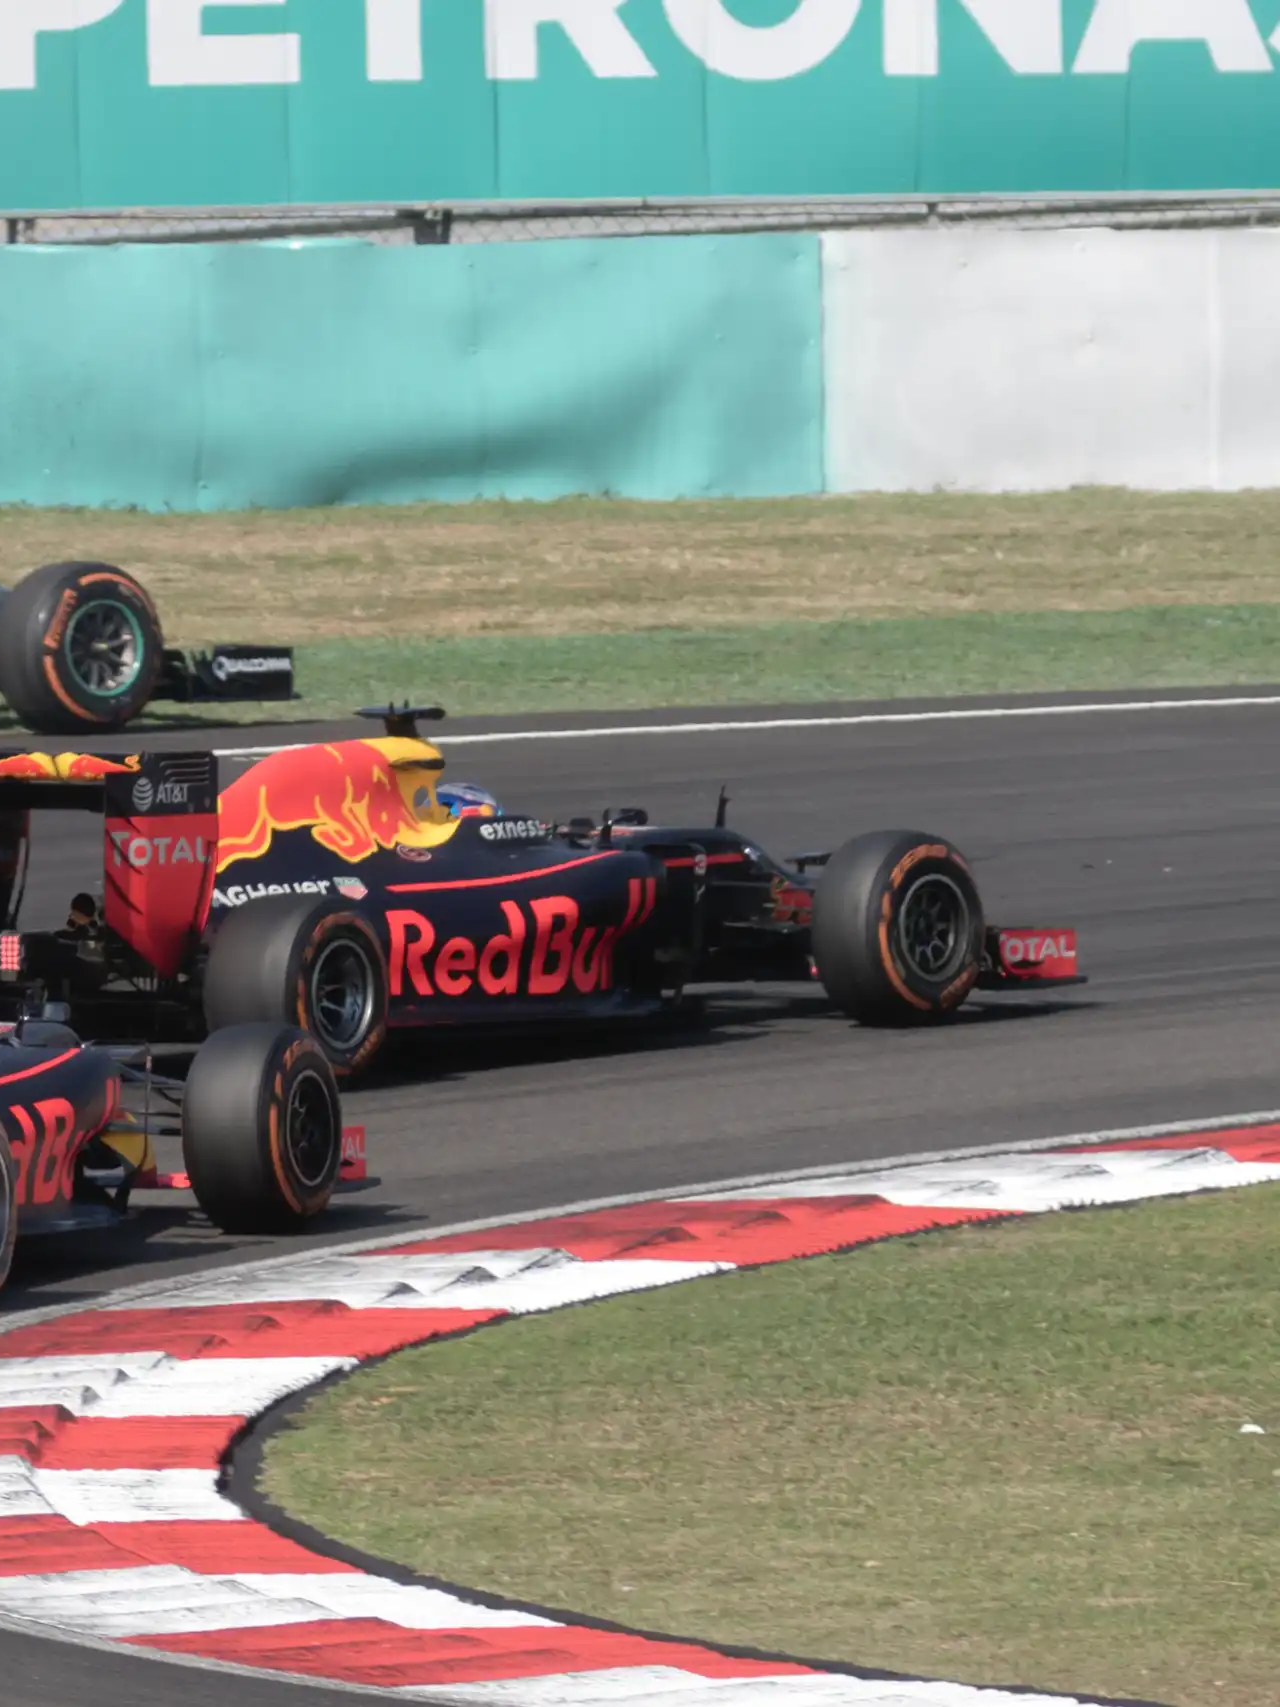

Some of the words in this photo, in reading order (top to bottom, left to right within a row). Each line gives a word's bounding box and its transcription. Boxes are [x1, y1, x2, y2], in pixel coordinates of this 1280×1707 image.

[156, 782, 189, 804] AT&T
[110, 830, 212, 867] TOTAL
[384, 899, 525, 996] Red
